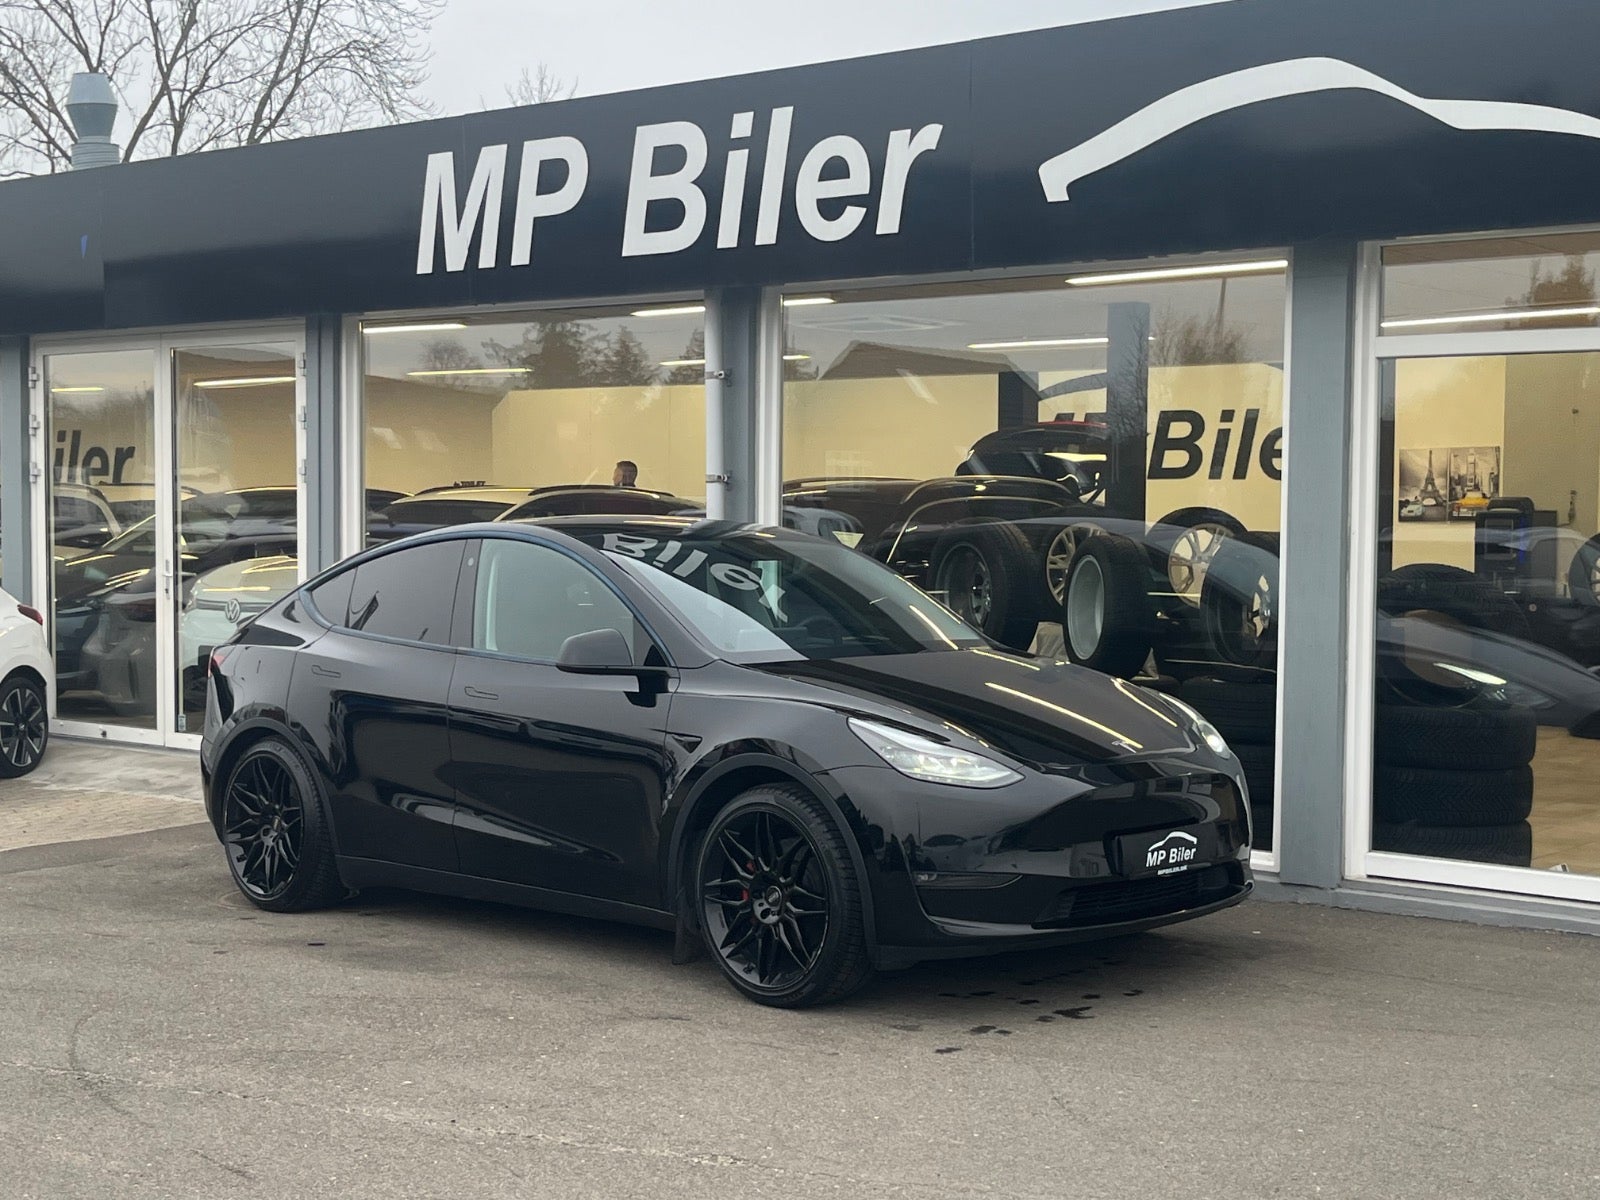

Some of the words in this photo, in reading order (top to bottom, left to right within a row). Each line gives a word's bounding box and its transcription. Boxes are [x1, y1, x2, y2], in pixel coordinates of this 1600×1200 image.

[416, 136, 589, 275] MP
[622, 106, 944, 257] Biler
[1146, 850, 1166, 867] MP
[1169, 847, 1196, 864] Biler
